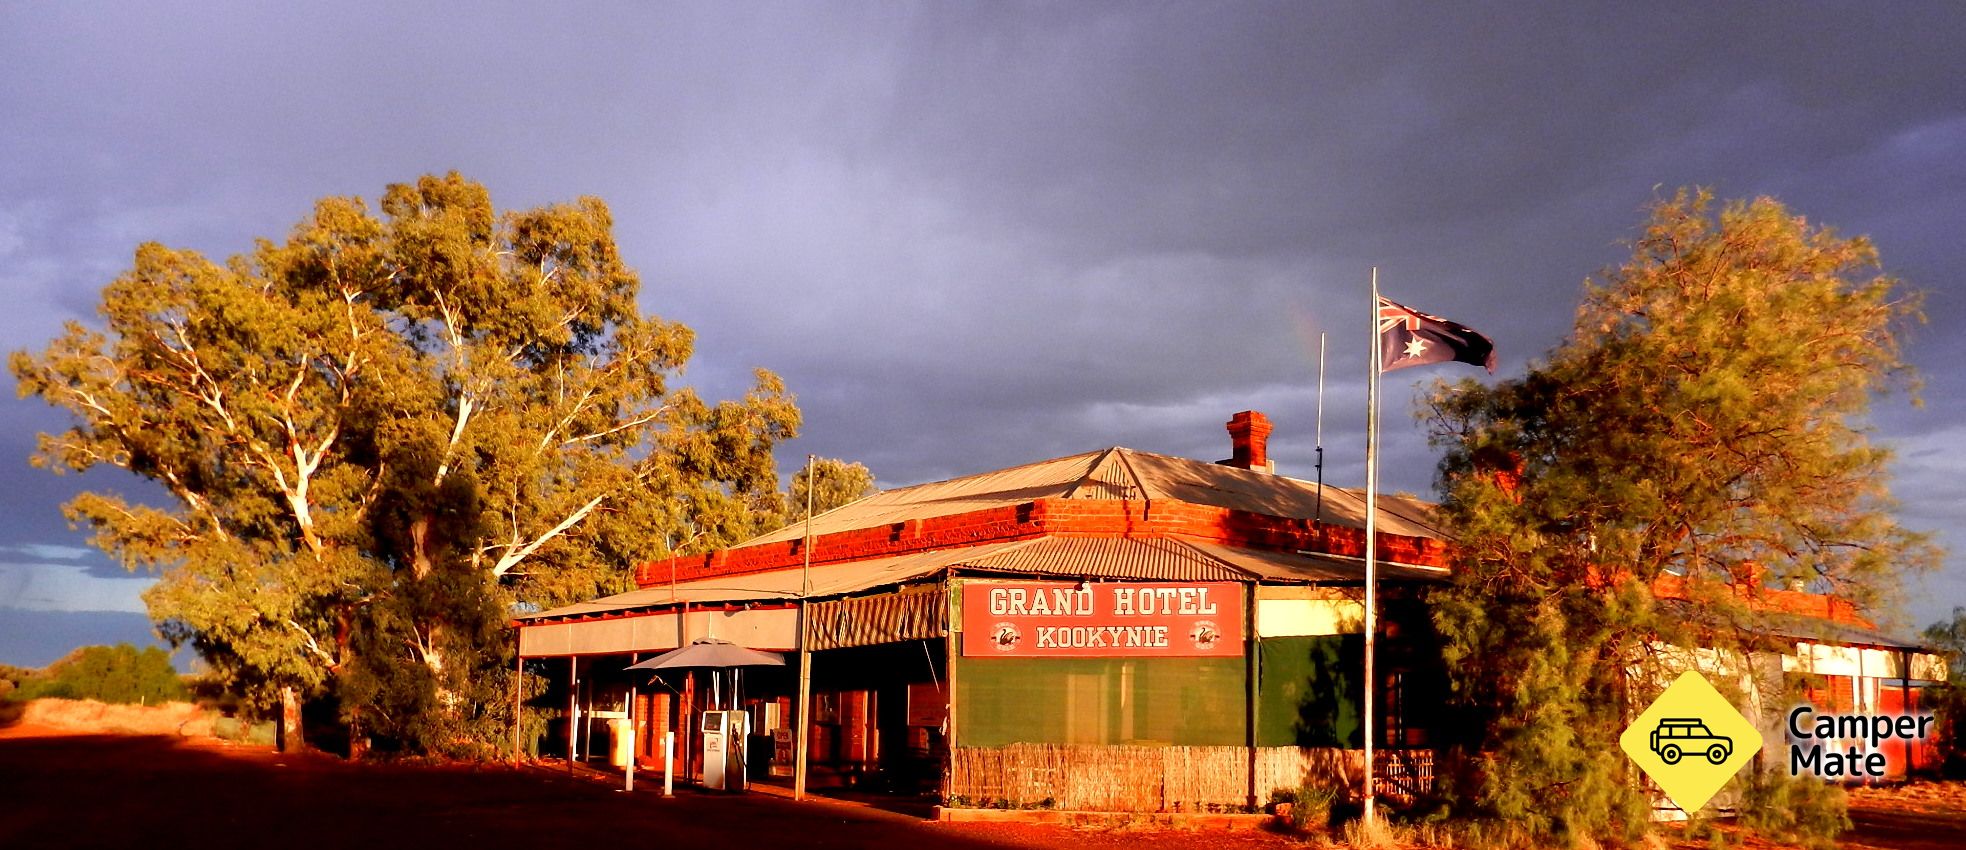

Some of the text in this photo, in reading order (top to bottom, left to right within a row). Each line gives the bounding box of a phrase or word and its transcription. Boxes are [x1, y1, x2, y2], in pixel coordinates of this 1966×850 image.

[989, 587, 1217, 616] GRAND HOTEL
[1036, 626, 1169, 648] KOOKYNIE
